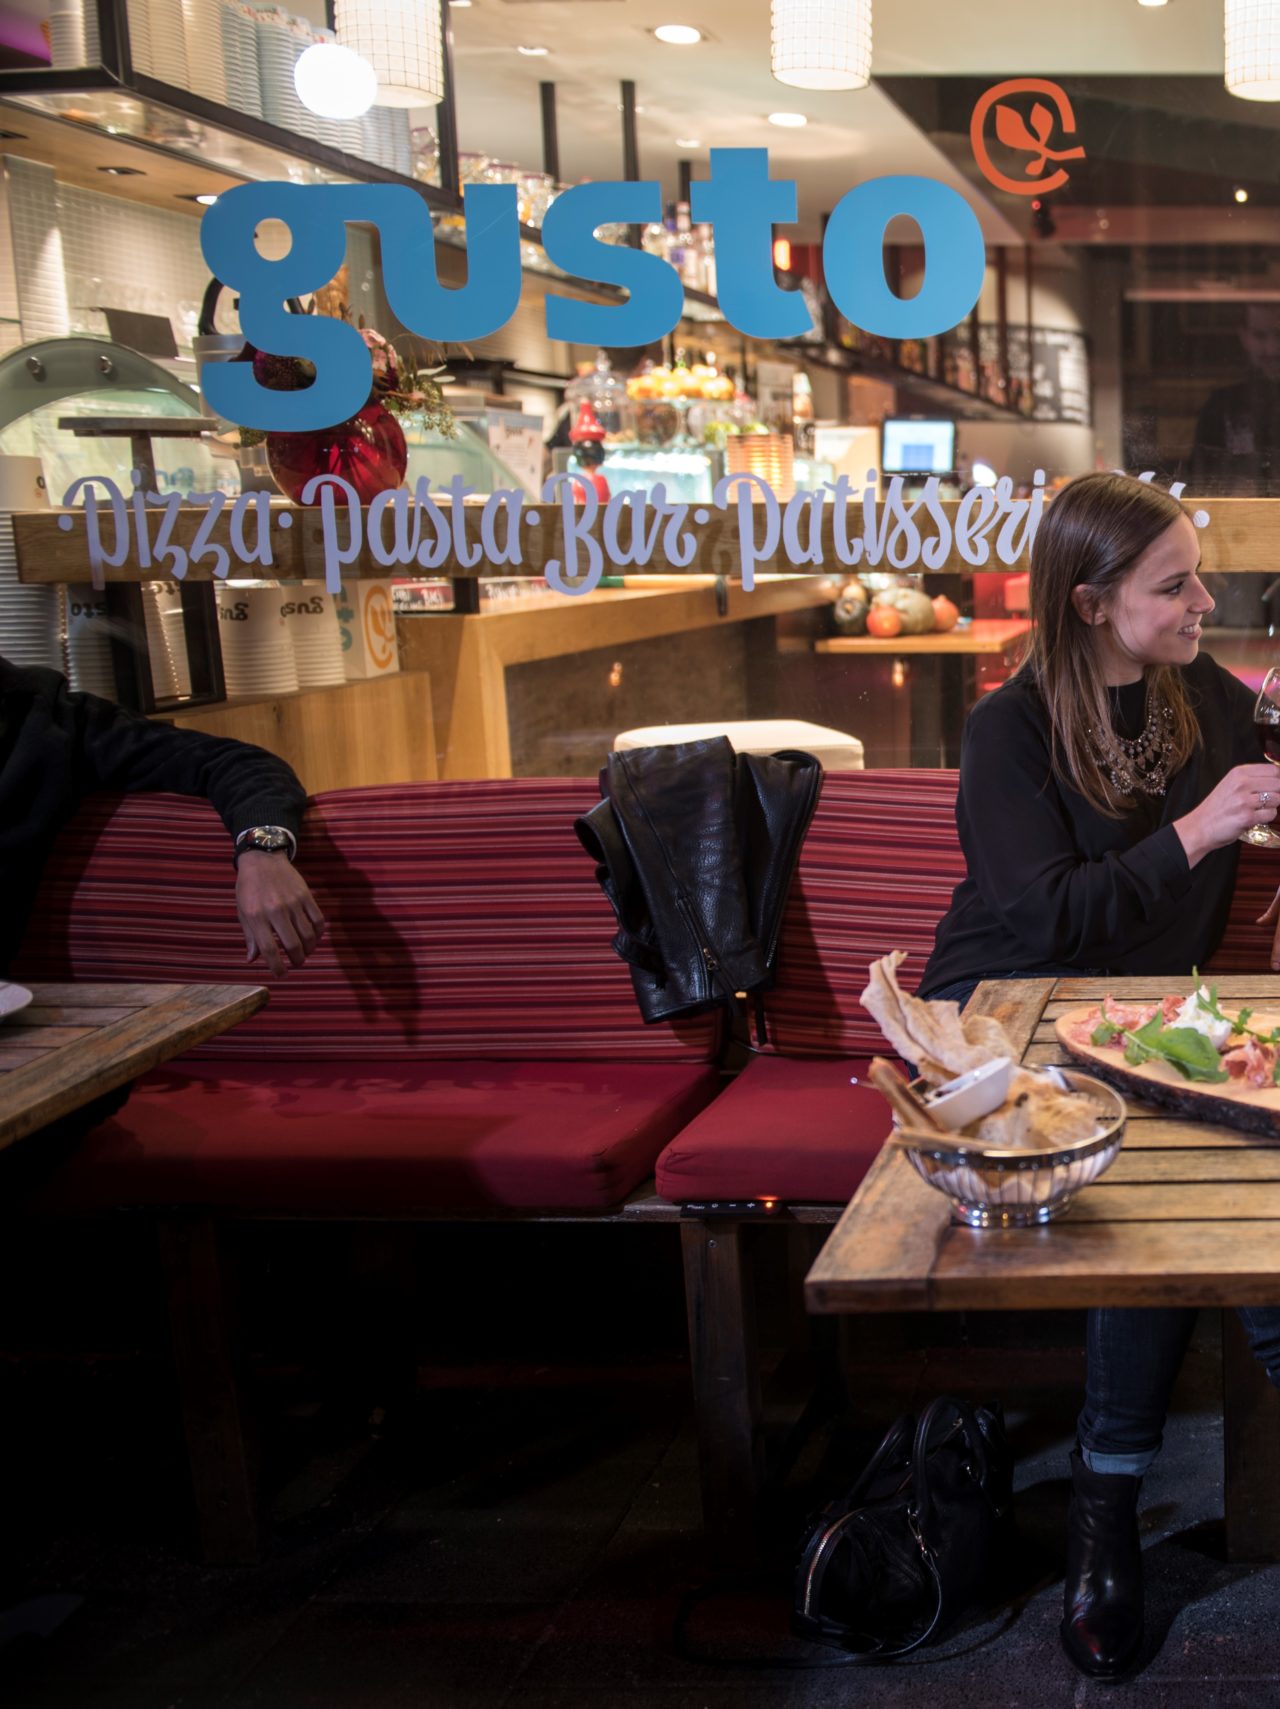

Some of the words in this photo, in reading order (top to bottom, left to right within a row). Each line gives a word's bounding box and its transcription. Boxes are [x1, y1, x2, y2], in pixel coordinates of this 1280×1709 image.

[200, 147, 986, 432] gusto
[62, 469, 274, 591] Pizza
[301, 473, 525, 593] Pasta
[542, 472, 697, 596] Bar
[715, 468, 1046, 592] Patisseri
